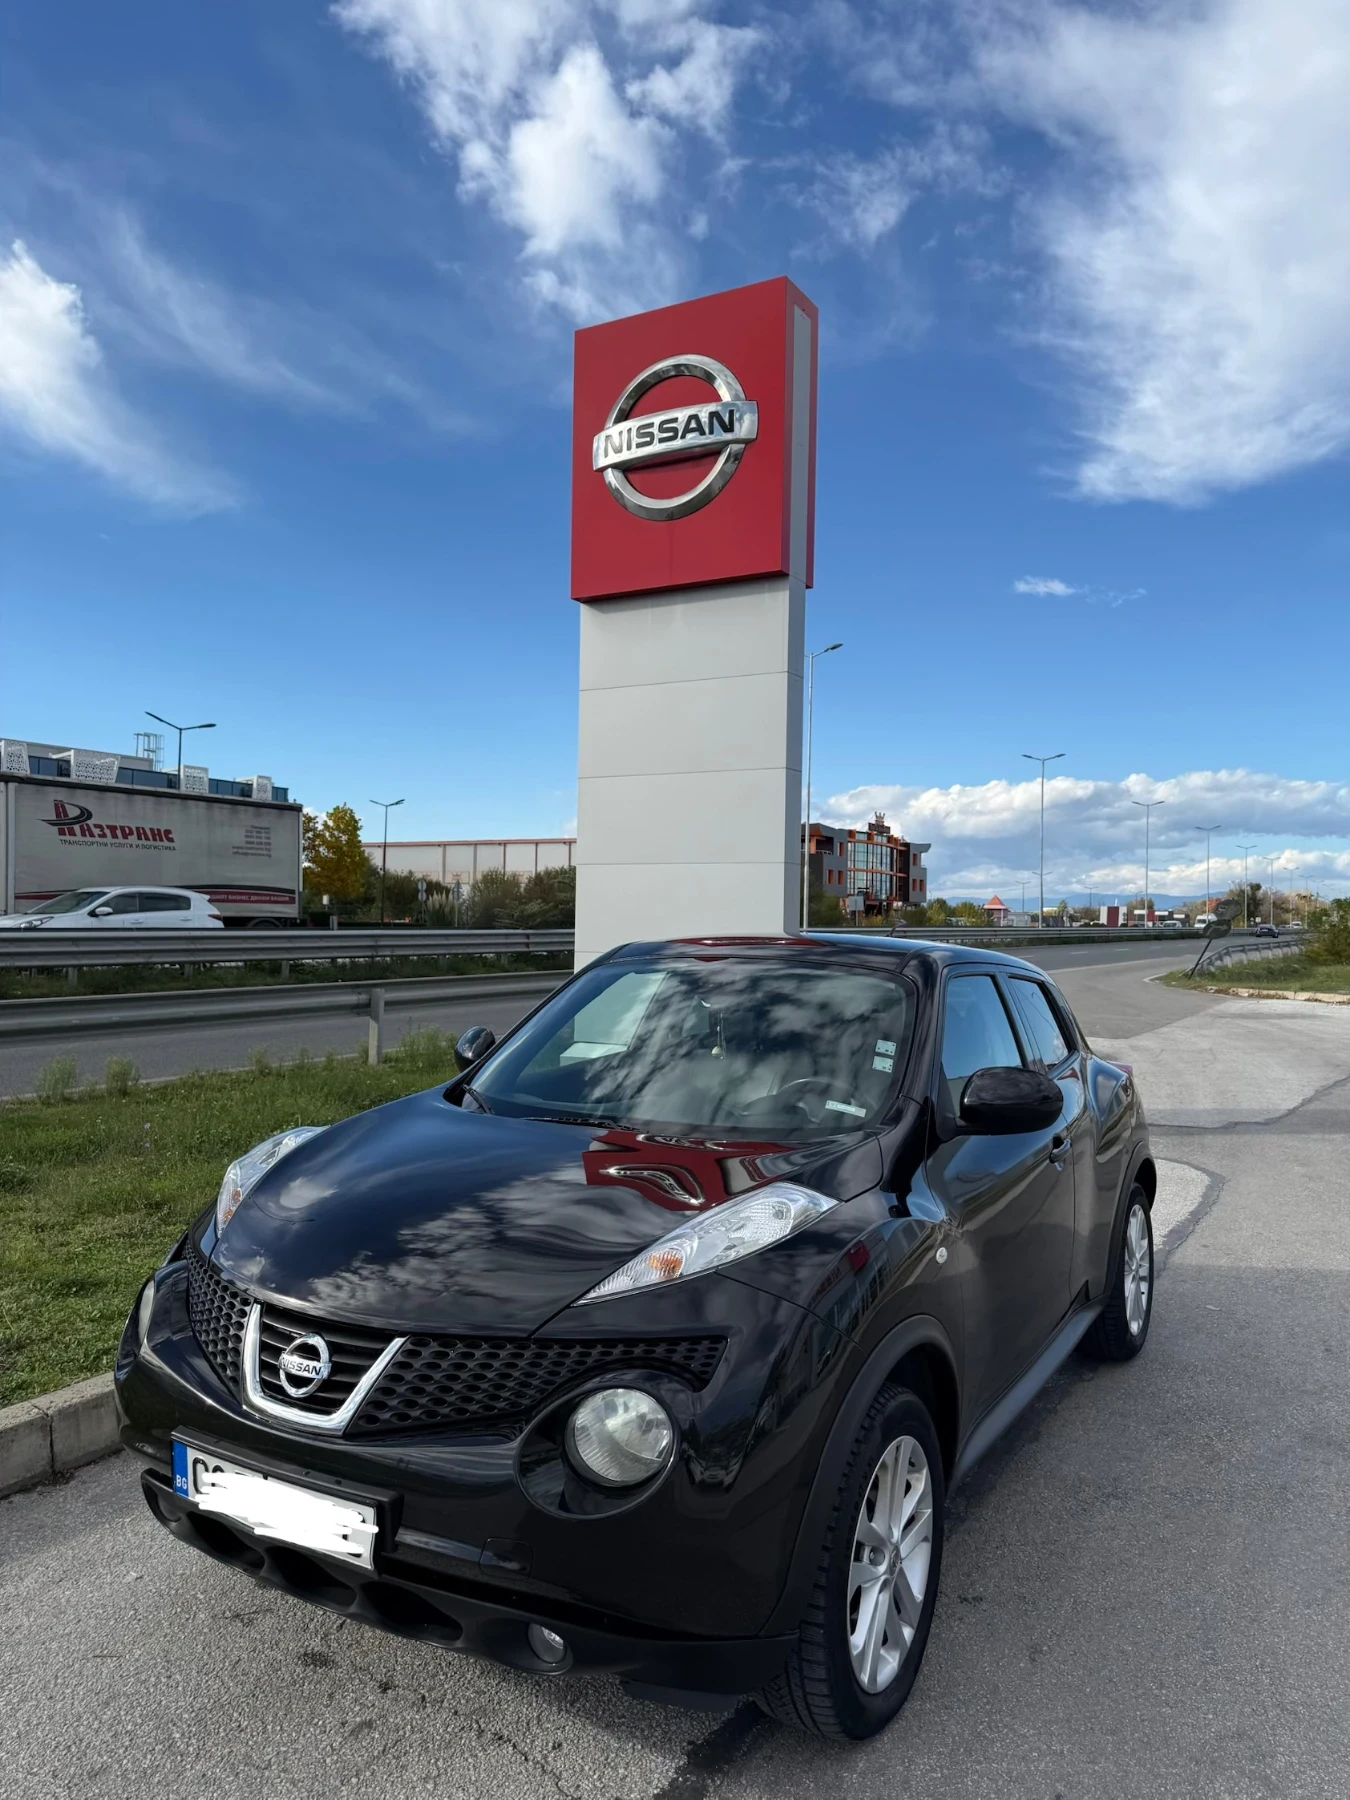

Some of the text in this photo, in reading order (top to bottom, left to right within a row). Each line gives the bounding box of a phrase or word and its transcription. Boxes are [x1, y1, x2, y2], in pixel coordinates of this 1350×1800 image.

[603, 409, 735, 458] NISSAN
[60, 839, 109, 848] ТРАНСПОРТНИ
[109, 841, 134, 849] УСЛУГИ
[141, 843, 177, 852] ЛОГИСТИКА
[281, 1356, 322, 1376] NISSAN
[176, 1474, 188, 1490] BG
